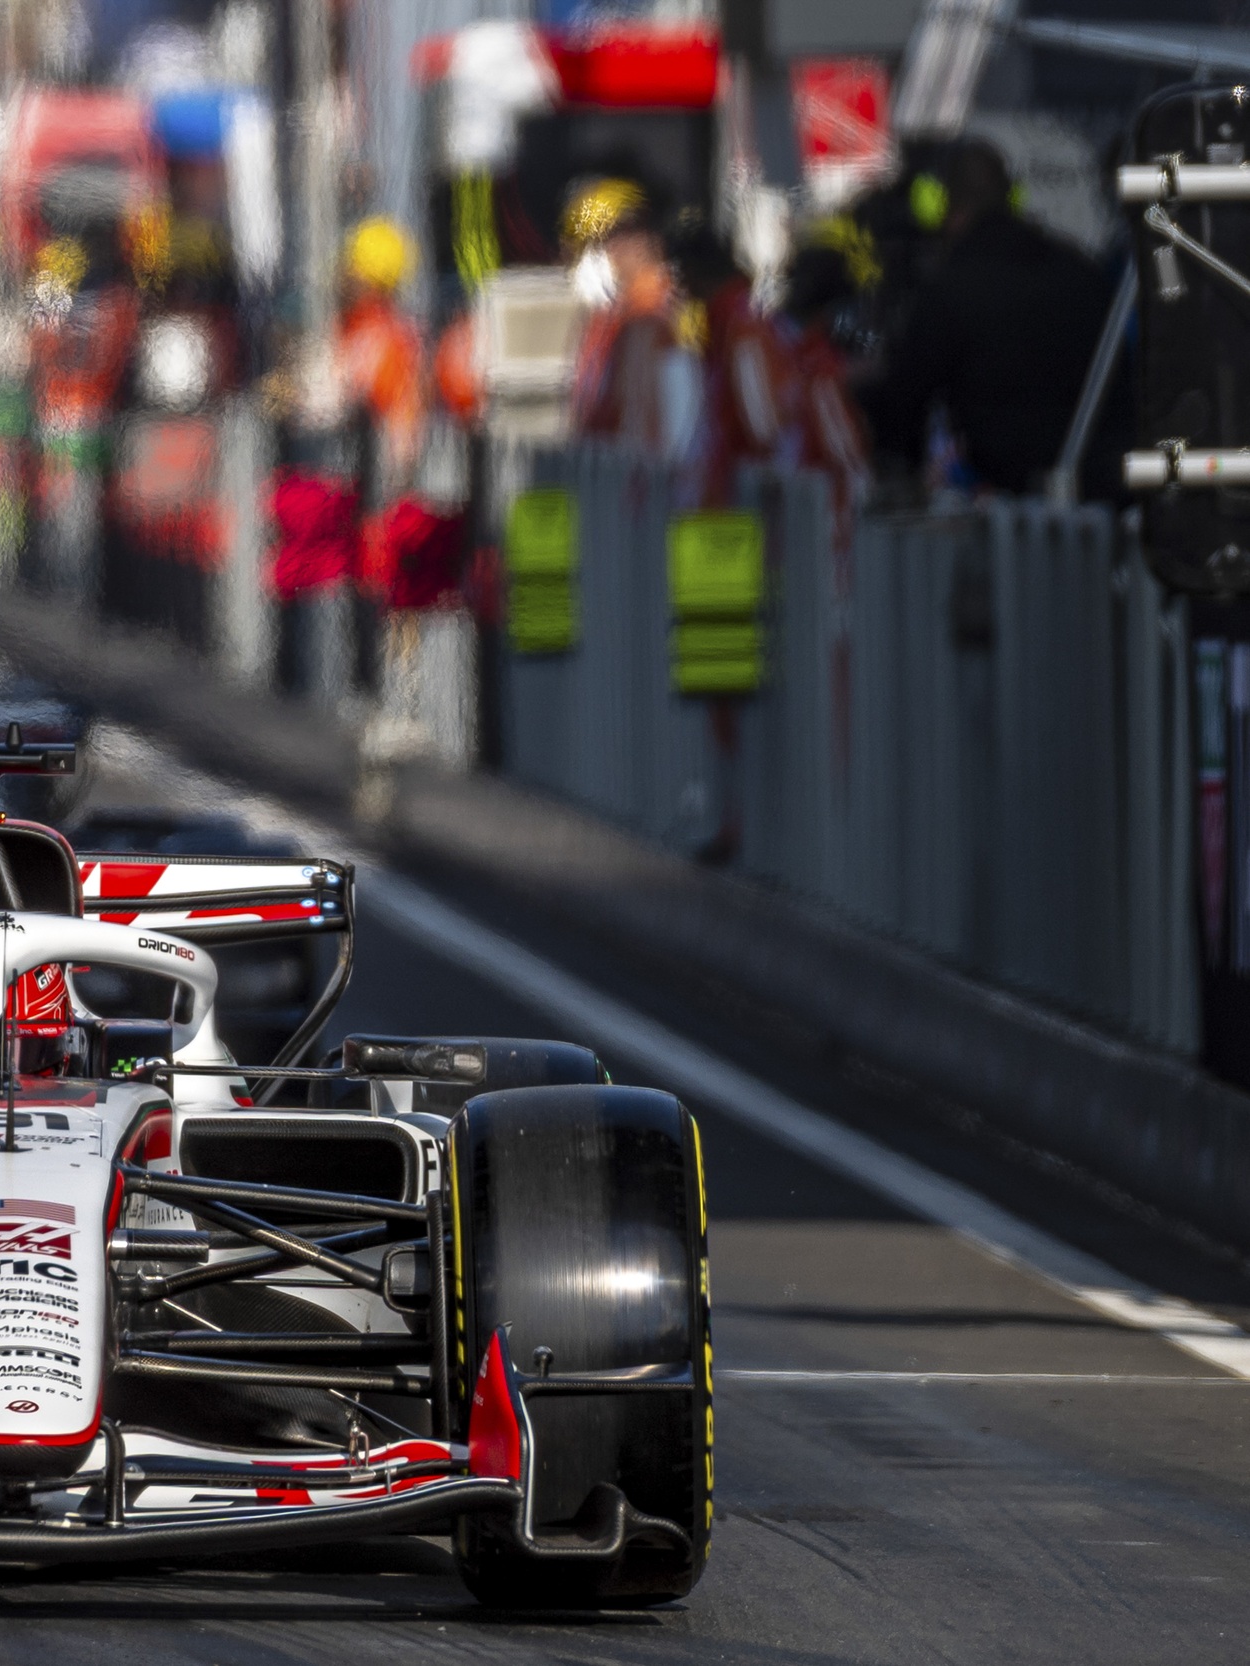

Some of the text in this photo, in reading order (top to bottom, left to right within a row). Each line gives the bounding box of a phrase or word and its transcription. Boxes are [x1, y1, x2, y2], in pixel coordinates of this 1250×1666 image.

[138, 937, 195, 962] ORION180
[37, 967, 55, 990] GR
[46, 1279, 80, 1292] Edge
